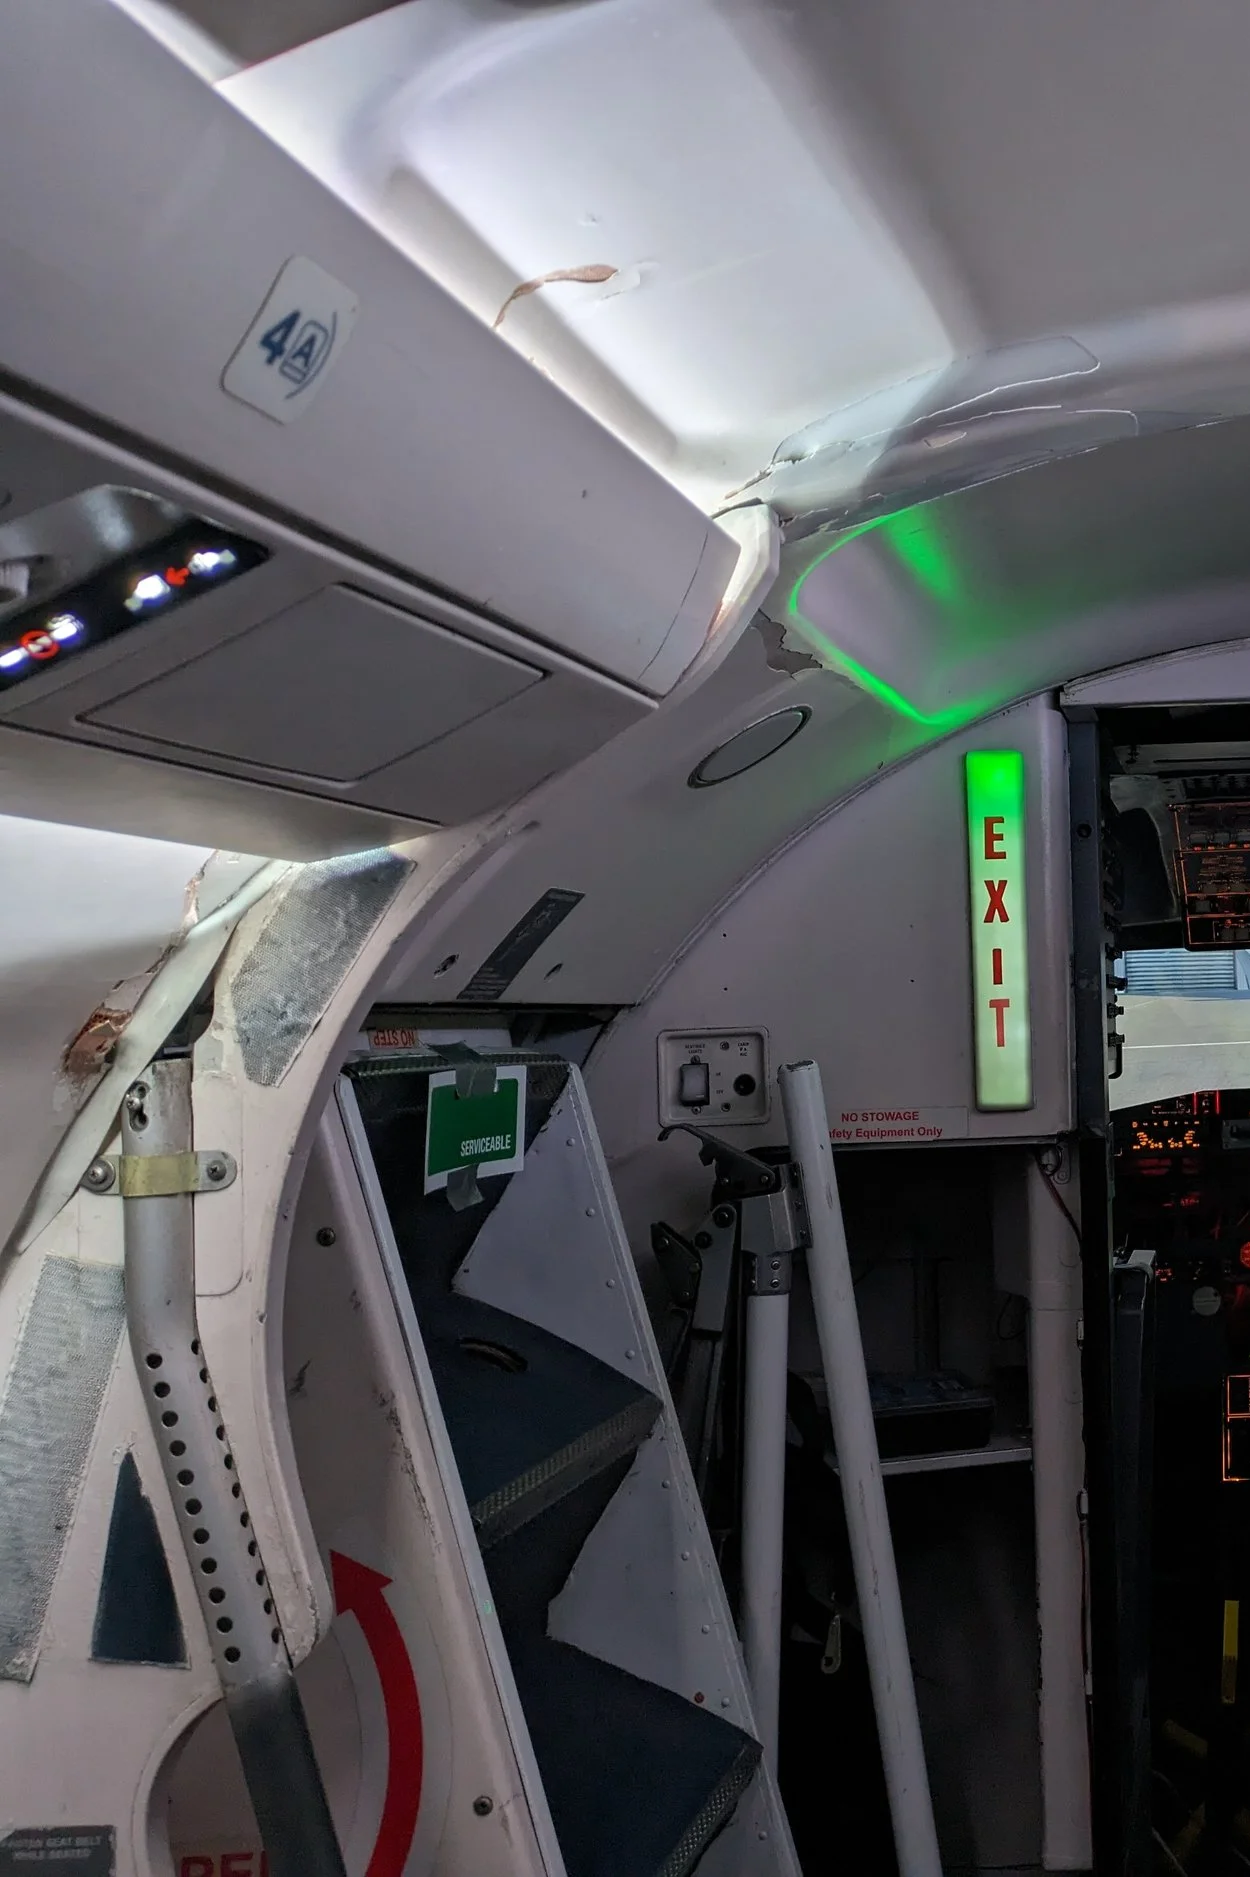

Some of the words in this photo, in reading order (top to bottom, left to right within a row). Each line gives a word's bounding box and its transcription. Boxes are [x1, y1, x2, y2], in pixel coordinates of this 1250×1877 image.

[983, 816, 1010, 1047] EXIT
[373, 1029, 399, 1046] STEP
[400, 1029, 416, 1046] NO
[841, 1112, 859, 1122] NO
[861, 1111, 920, 1122] STOWAGE
[855, 1128, 914, 1140] Equipment
[917, 1126, 943, 1138] Only
[460, 1134, 512, 1157] SERVICEABLE
